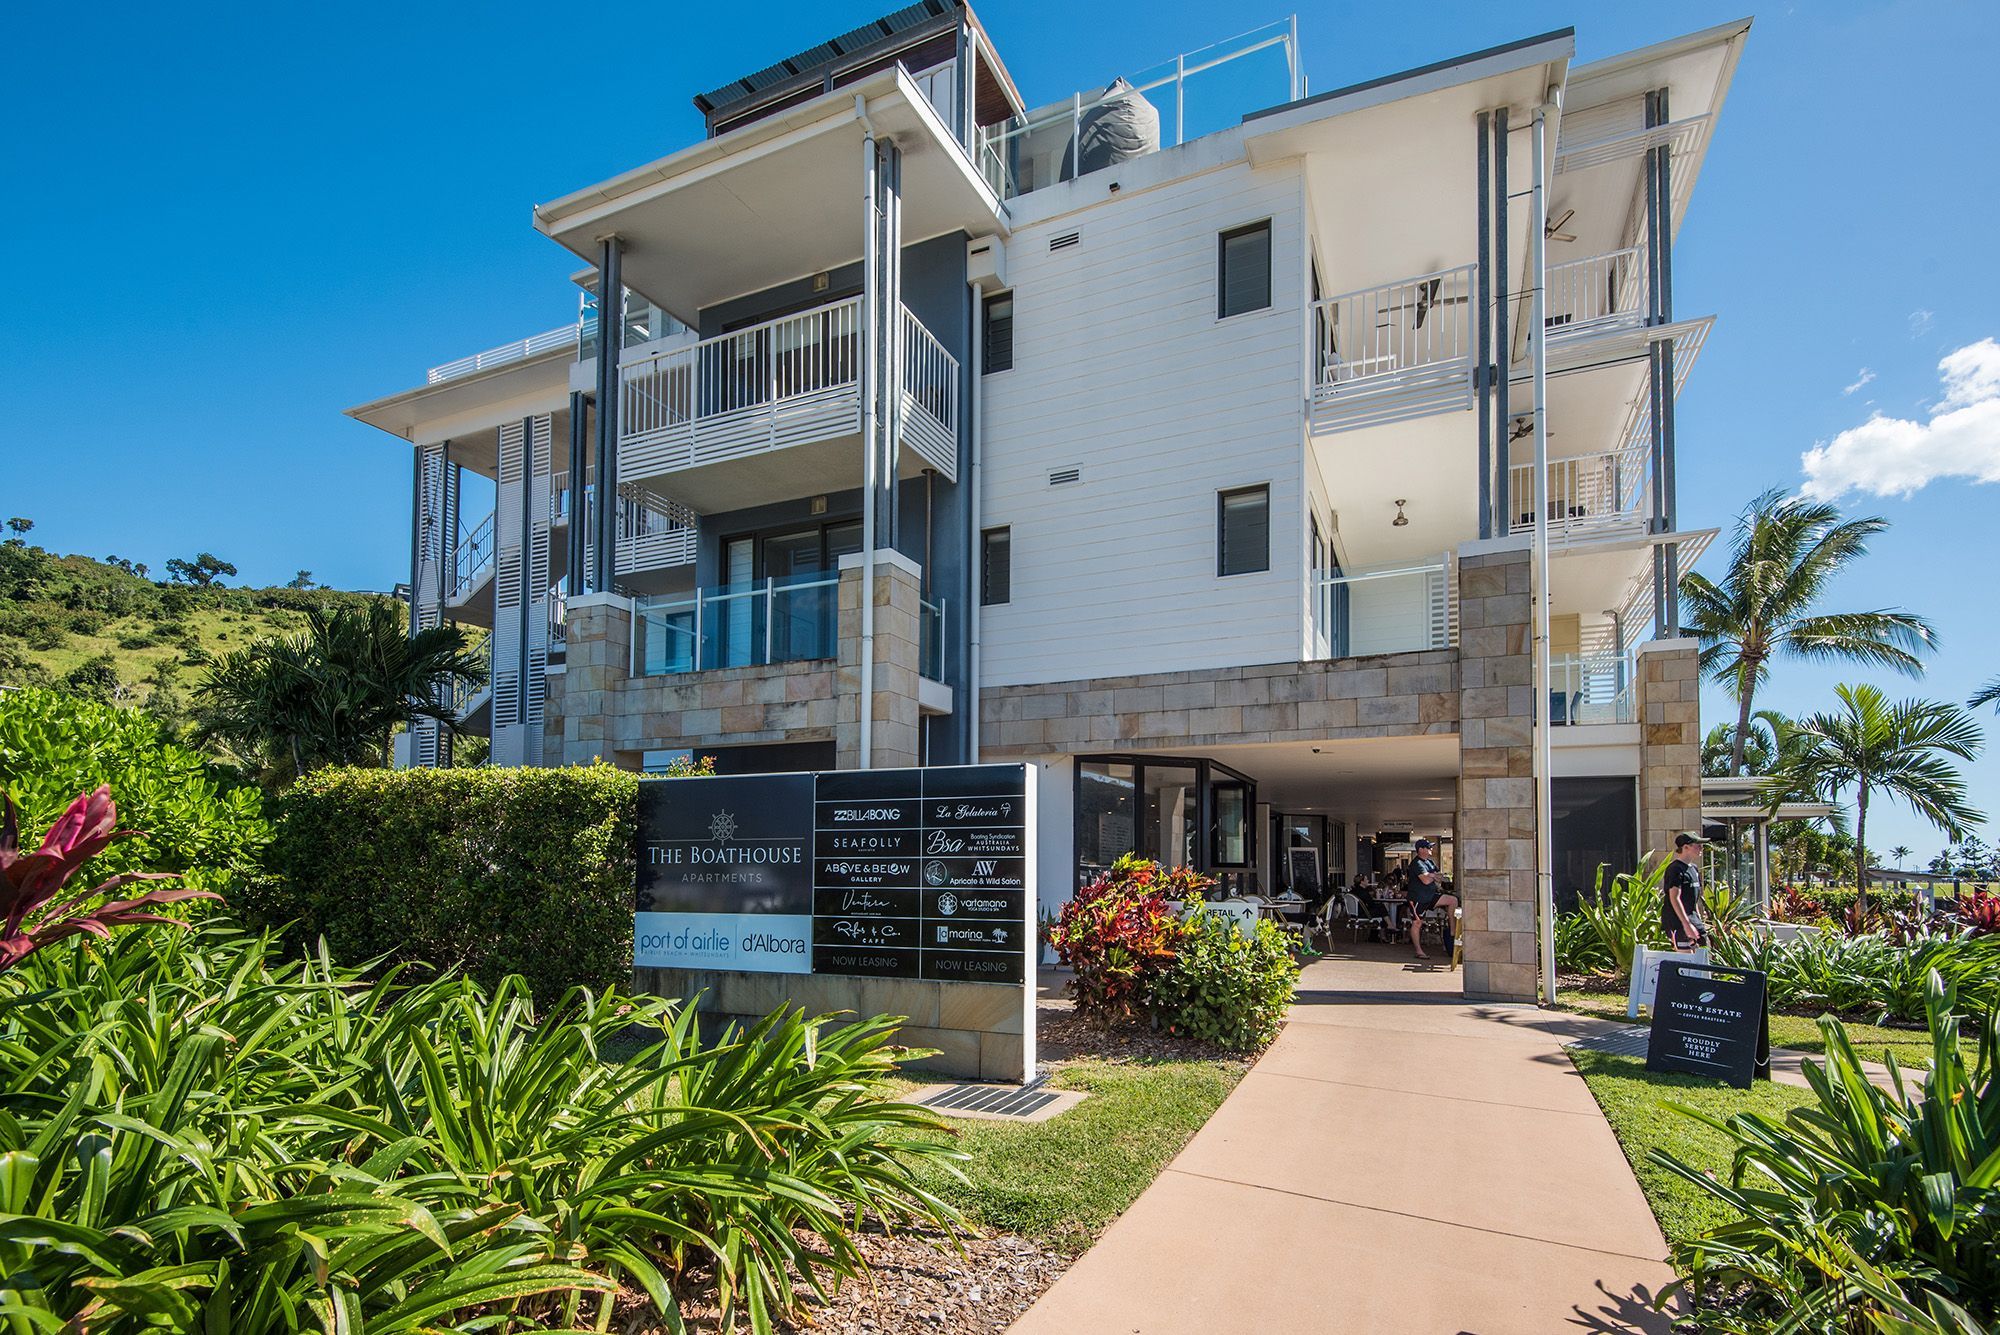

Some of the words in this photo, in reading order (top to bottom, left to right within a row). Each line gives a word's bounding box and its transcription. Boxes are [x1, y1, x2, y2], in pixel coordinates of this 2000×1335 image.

[847, 809, 900, 821] BILLABONG
[936, 806, 951, 818] La
[955, 805, 998, 820] Gelateria
[834, 838, 901, 848] SEAFOLLY
[648, 847, 682, 864] THE
[691, 846, 801, 864] BOATHOUSE
[825, 862, 861, 874] ABOVE
[863, 865, 870, 873] &
[872, 863, 910, 875] BELOW
[971, 861, 998, 876] AW
[682, 873, 762, 883] APARTMENTS
[1001, 877, 1021, 885] Salon
[960, 899, 1007, 908] vartamana
[1206, 908, 1236, 918] RETAIL
[949, 929, 983, 939] marina
[641, 931, 671, 954] port
[673, 927, 690, 950] of
[692, 928, 730, 951] airlie
[742, 933, 806, 954] d'Albora
[833, 956, 856, 966] NOW
[859, 957, 898, 968] LEASING
[935, 960, 961, 970] NOW
[964, 961, 1008, 972] LEASING
[1670, 1001, 1703, 1012] TOBY'S
[1706, 1007, 1742, 1018] ESTATE
[1682, 1036, 1721, 1047] PROUDLY
[1684, 1043, 1716, 1053] SERVED
[1688, 1050, 1711, 1059] HERE
